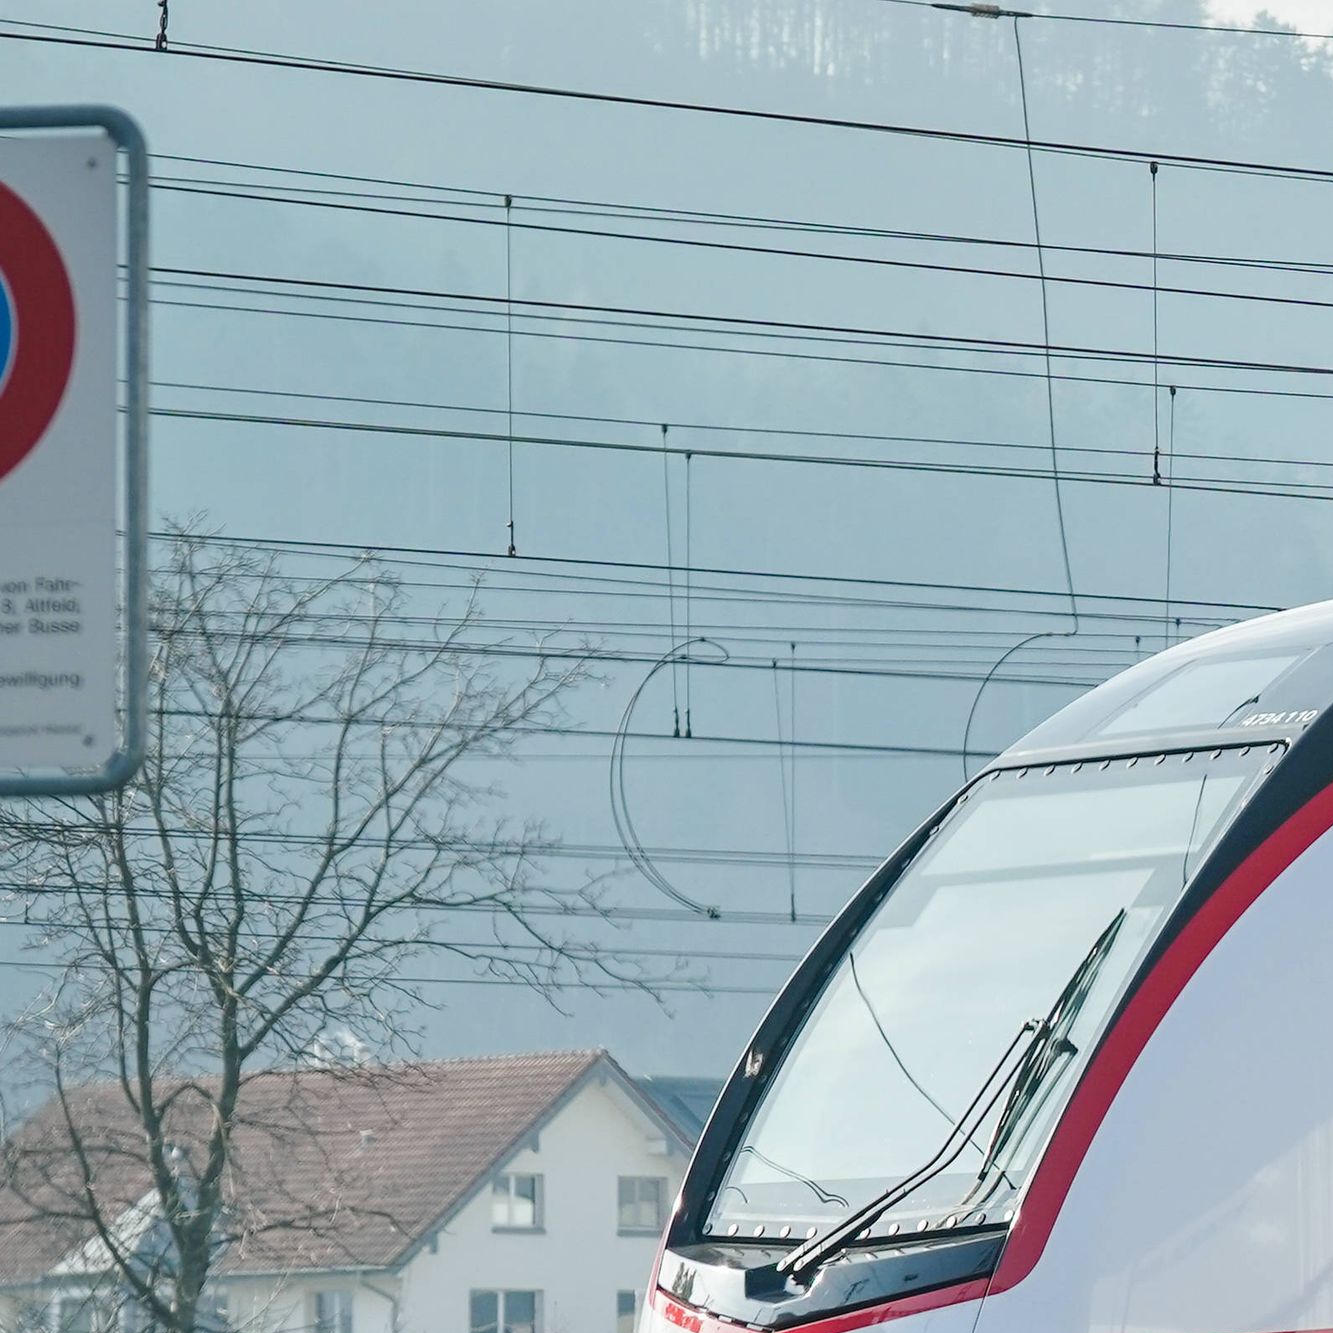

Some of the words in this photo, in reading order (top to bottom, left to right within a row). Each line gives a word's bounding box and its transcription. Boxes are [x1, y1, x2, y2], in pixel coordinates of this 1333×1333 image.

[28, 618, 81, 634] Busse
[1242, 711, 1287, 727] 4734
[1285, 709, 1319, 723] 110
